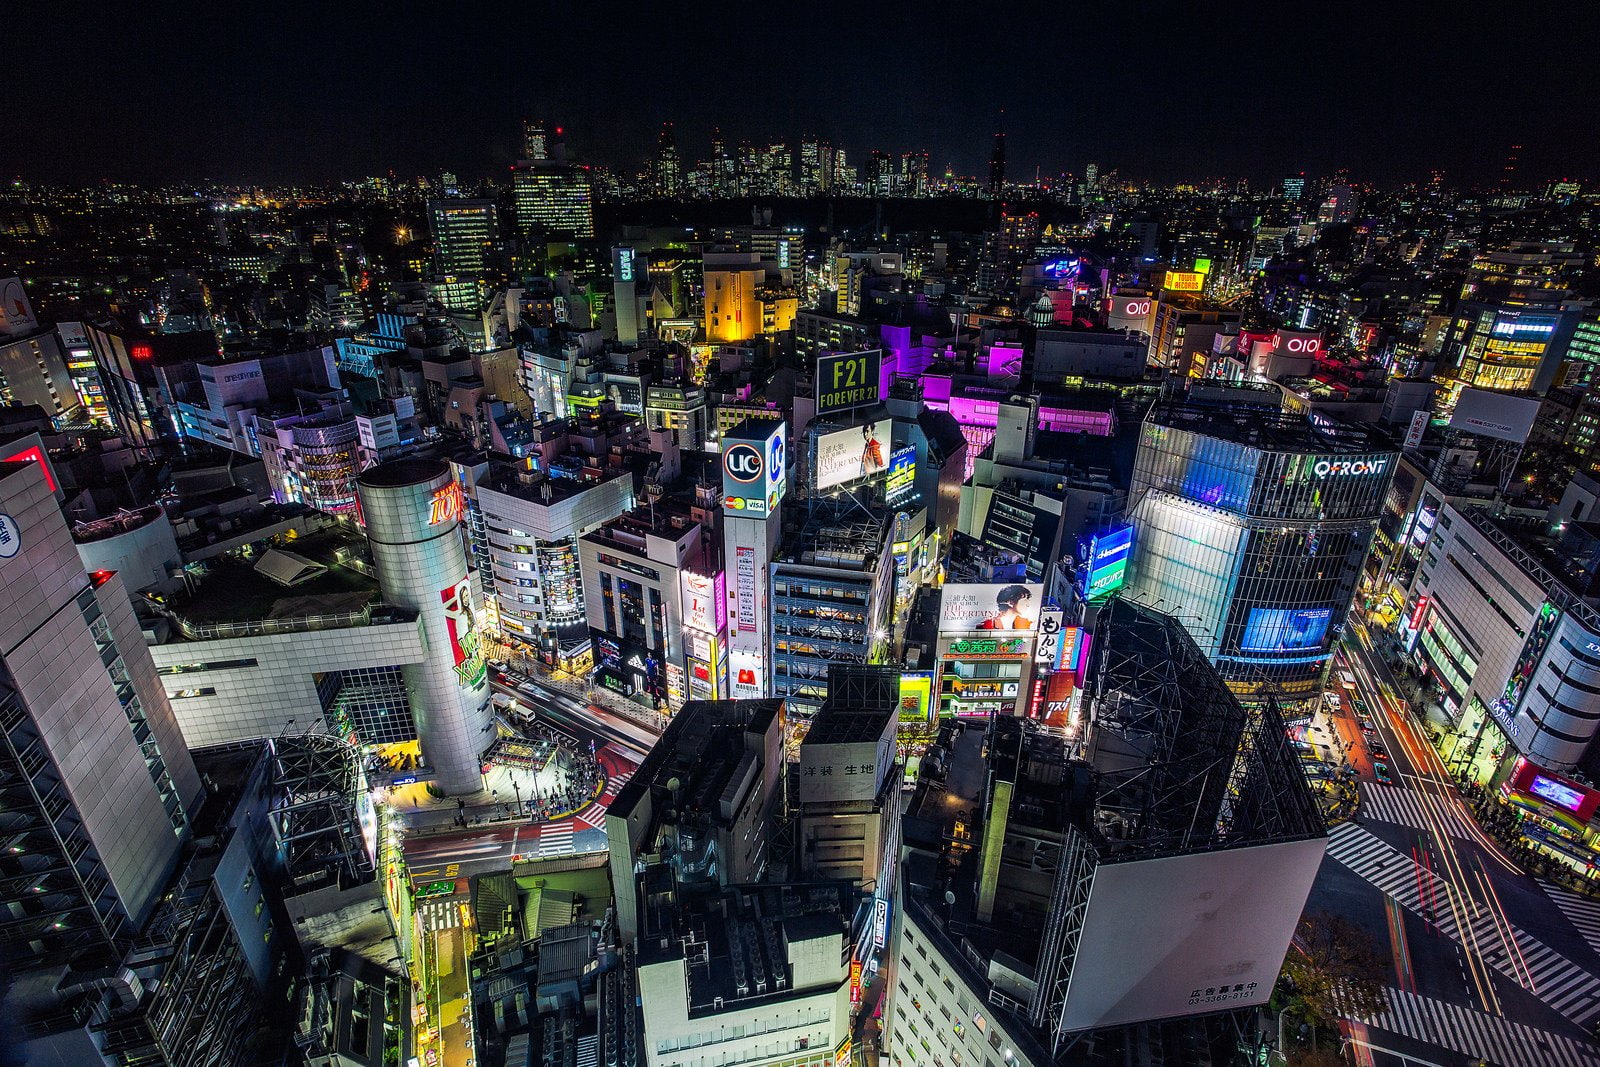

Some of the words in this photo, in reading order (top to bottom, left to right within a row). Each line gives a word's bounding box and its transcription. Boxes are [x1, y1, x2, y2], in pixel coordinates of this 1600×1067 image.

[833, 358, 867, 389] F21
[820, 387, 865, 408] FOREVER
[867, 385, 878, 400] 21
[729, 454, 760, 474] UC
[1314, 460, 1386, 479] QFRONT
[1038, 616, 1060, 661] もんじゃ
[962, 690, 1001, 698] Euphoria
[804, 766, 833, 777] 洋装
[844, 764, 874, 776] 生地
[1188, 991, 1255, 1006] 03-3369-8151
[1190, 981, 1258, 998] 広告募集中
